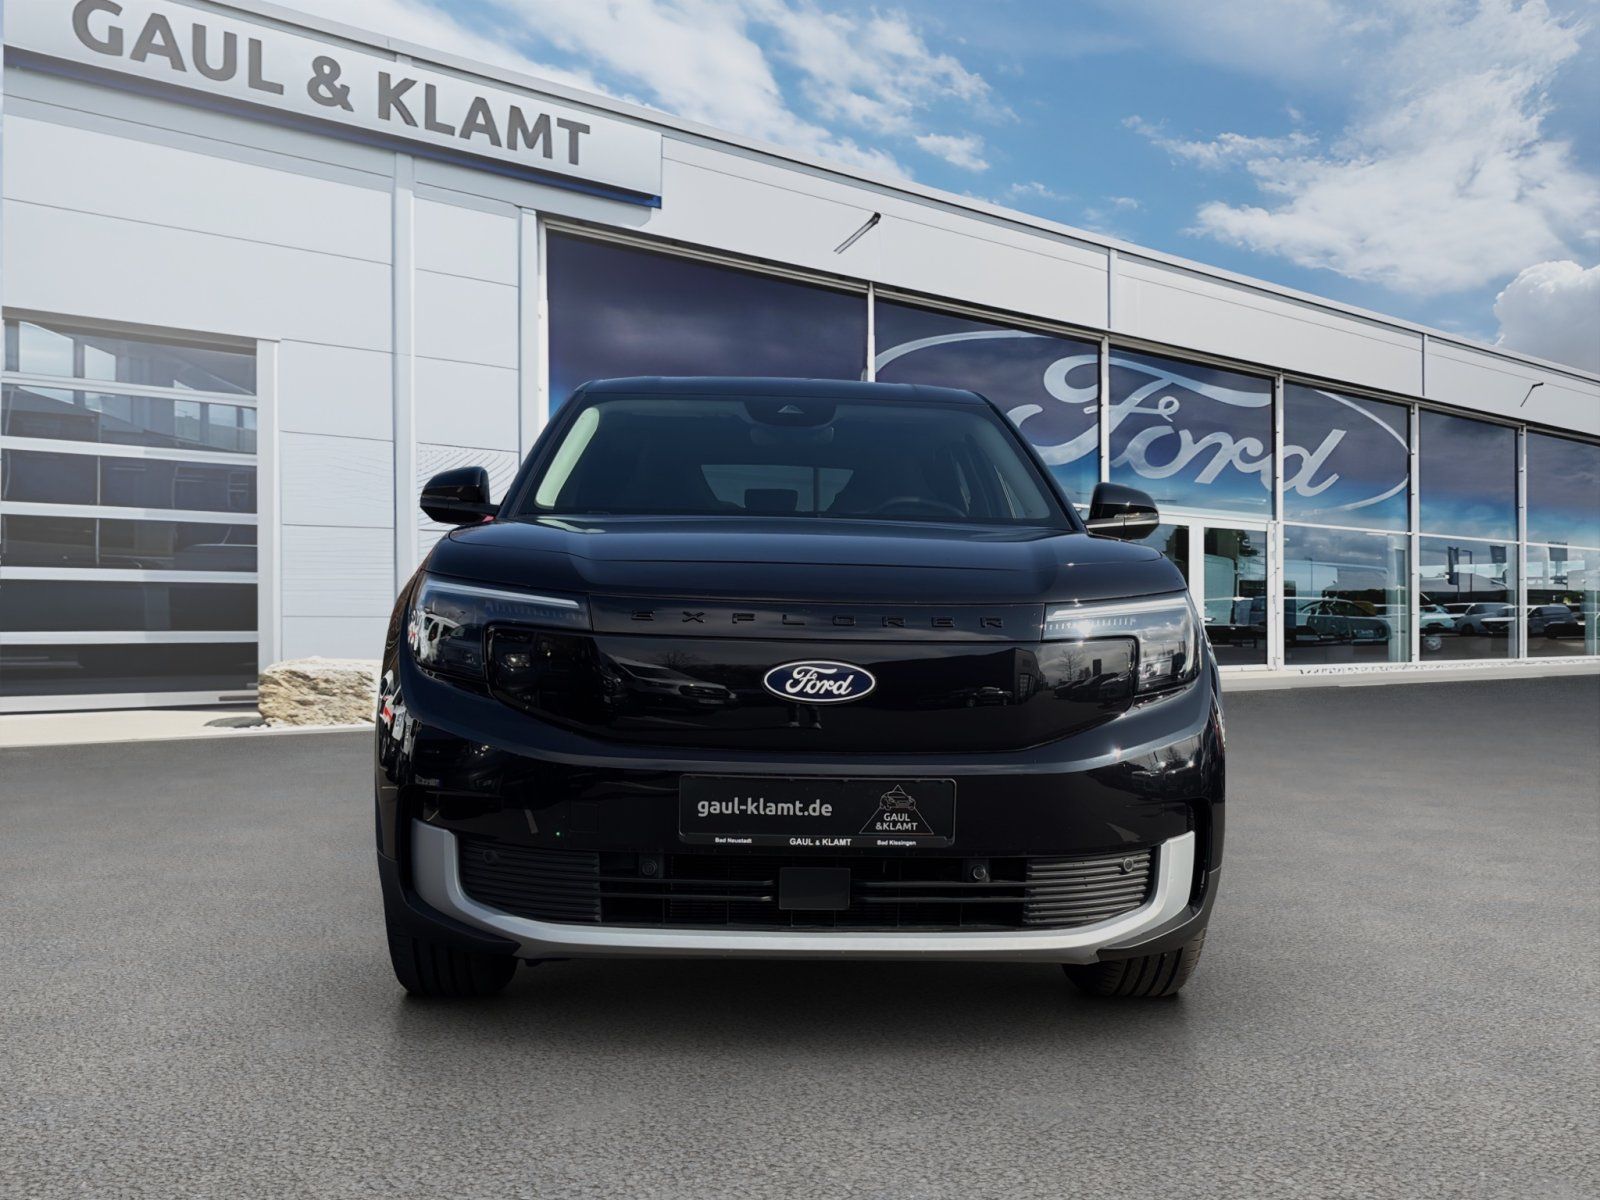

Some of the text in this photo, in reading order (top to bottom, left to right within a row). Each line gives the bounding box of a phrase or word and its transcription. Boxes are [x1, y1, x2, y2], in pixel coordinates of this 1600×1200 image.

[72, 0, 591, 165] GAUL & KLAMT
[1006, 354, 1347, 497] Ford
[630, 609, 1005, 629] EXPLORER
[785, 665, 854, 696] Ford
[697, 797, 833, 817] gaul-klamt.de
[883, 812, 911, 822] GAUL
[875, 822, 918, 831] &KLAMT
[789, 838, 813, 846] GAUL
[822, 838, 852, 847] KLAMT
